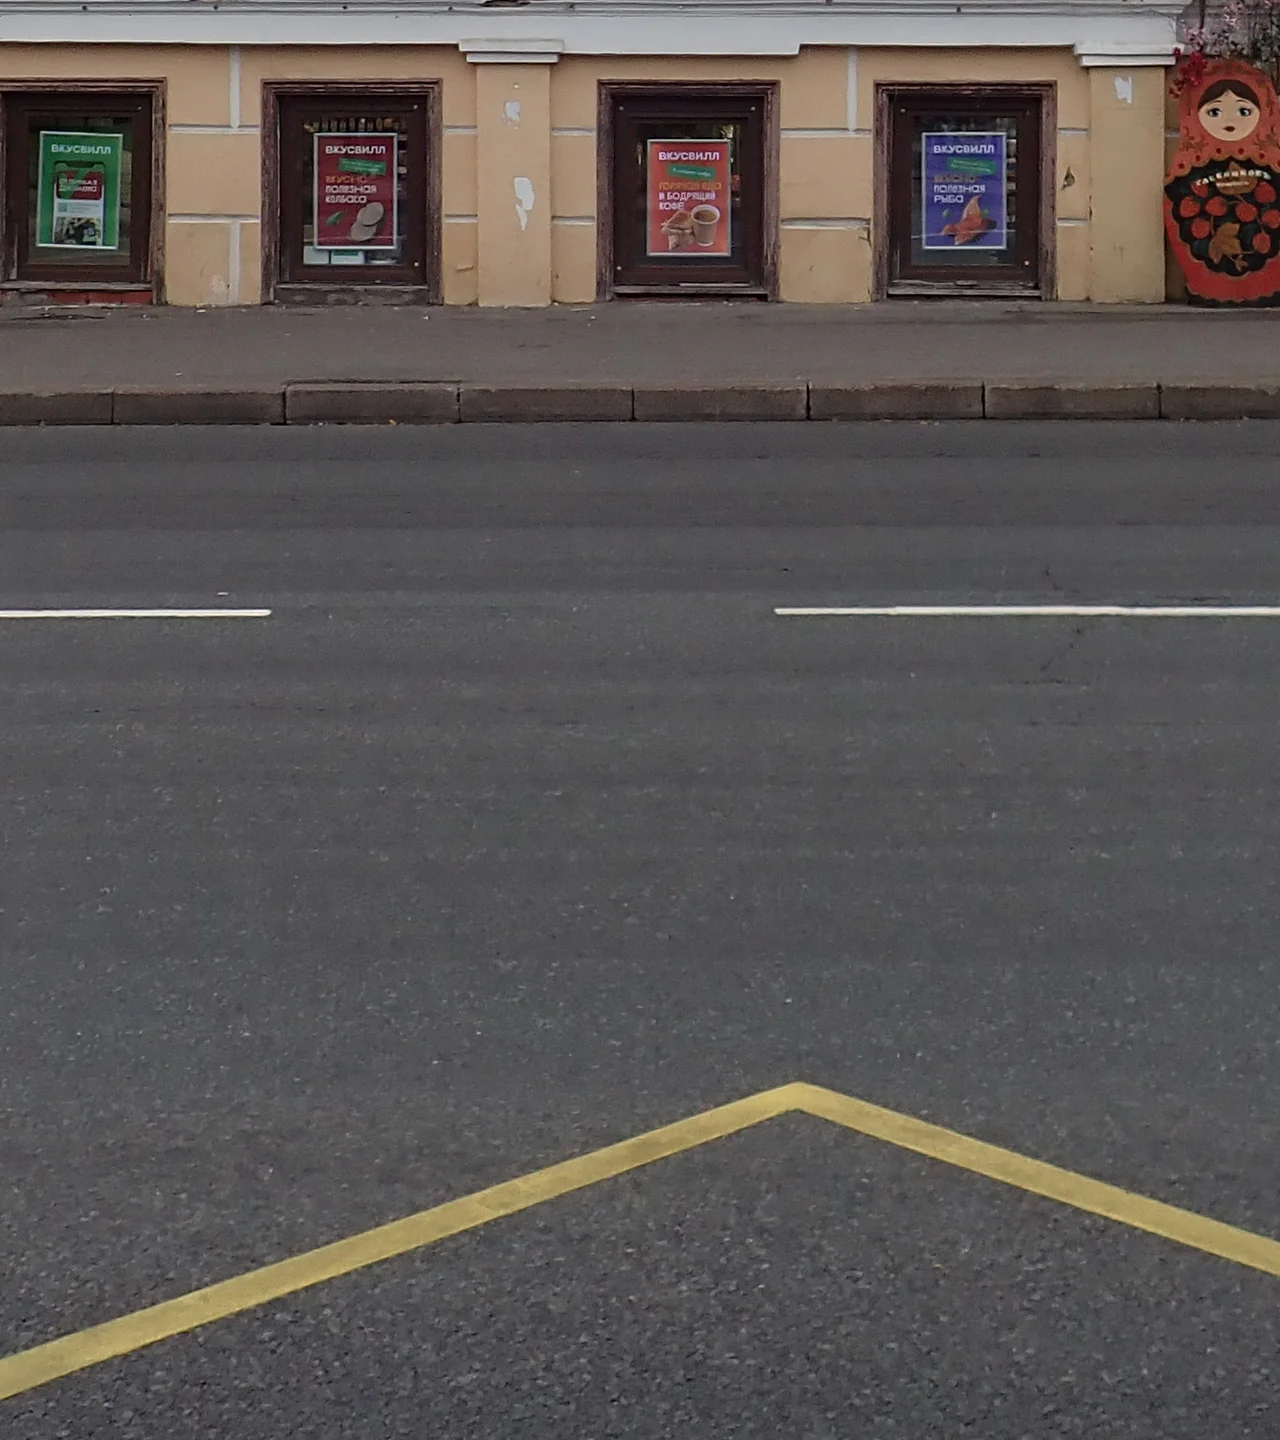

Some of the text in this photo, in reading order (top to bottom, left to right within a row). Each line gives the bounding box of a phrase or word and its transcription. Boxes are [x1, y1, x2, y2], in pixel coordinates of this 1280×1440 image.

[51, 144, 112, 155] ВКУСВИЛЛ
[325, 145, 386, 155] ВКУСВИЛЛ
[933, 144, 995, 154] ВКУСВИЛЛ
[658, 151, 720, 161] ВКУСВИЛЛ
